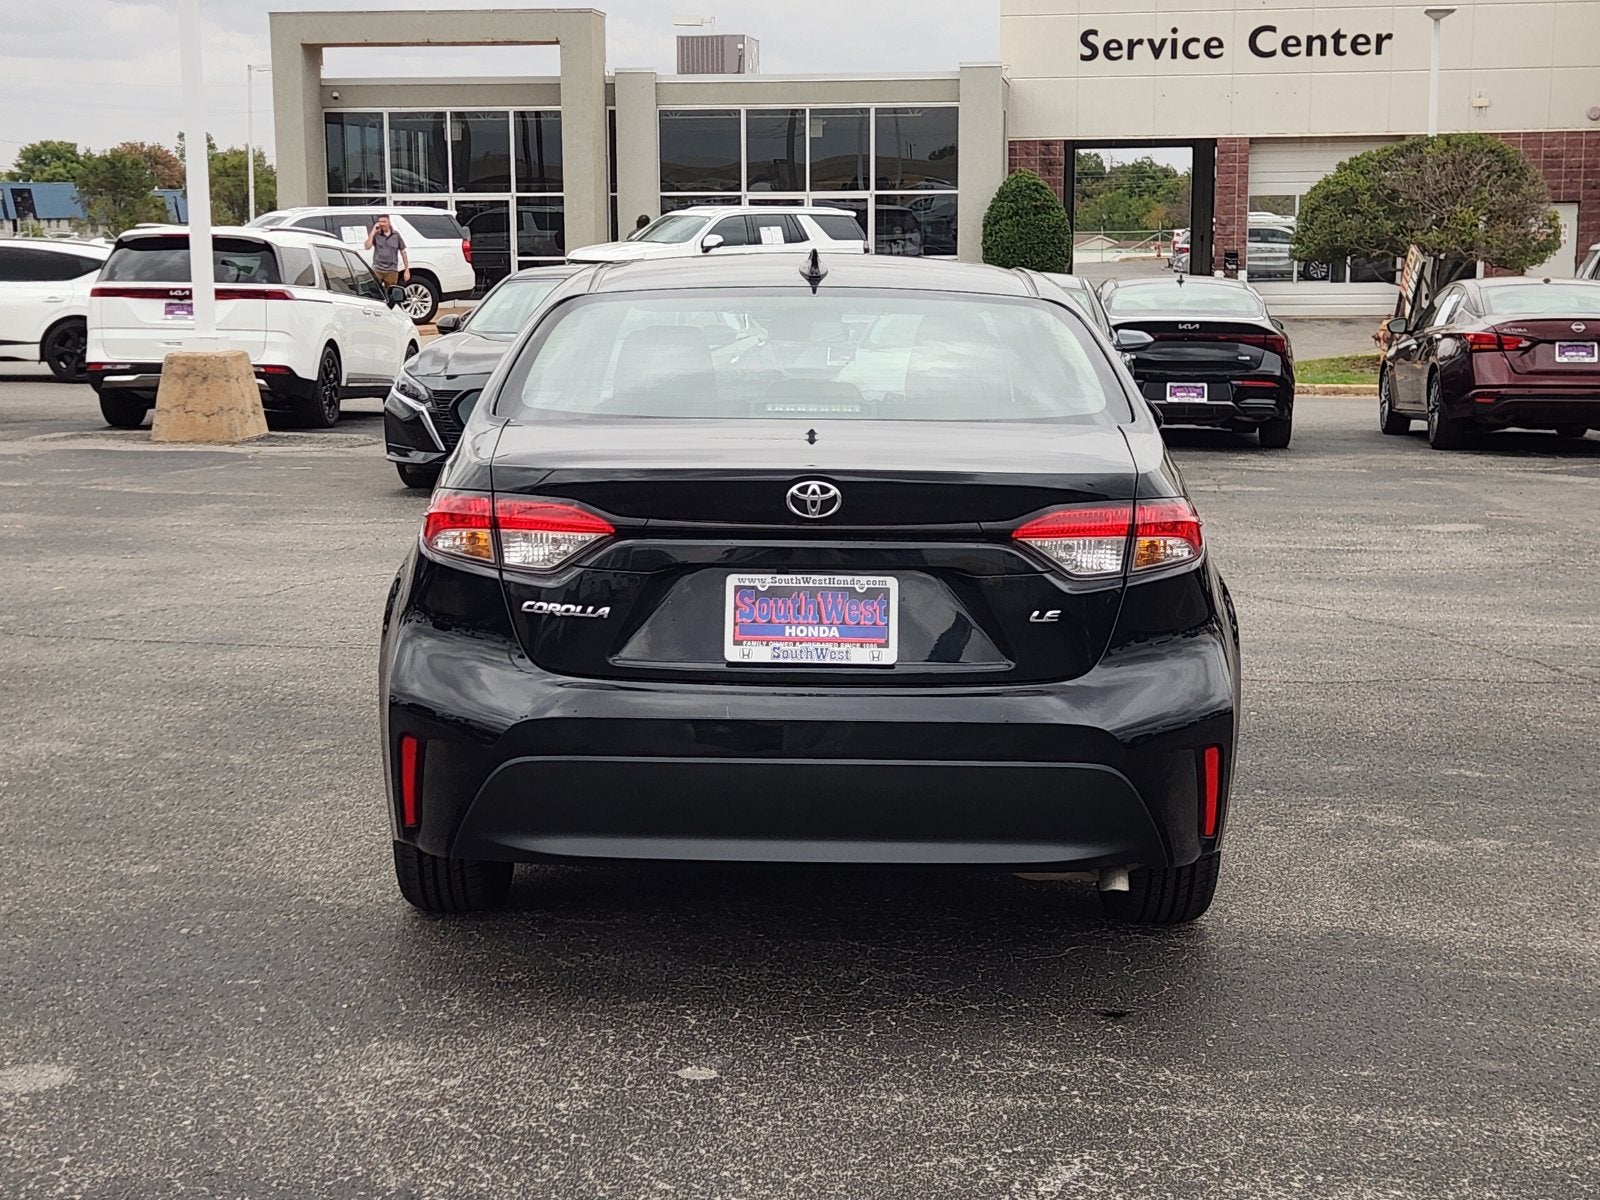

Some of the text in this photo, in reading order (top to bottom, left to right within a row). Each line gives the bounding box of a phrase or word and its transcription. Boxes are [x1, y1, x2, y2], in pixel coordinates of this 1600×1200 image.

[1079, 25, 1394, 62] Service Center
[521, 601, 611, 619] COROLLA
[735, 588, 888, 625] SouthWest
[1029, 610, 1062, 623] LE
[784, 625, 840, 638] HONDA
[771, 646, 850, 661] SouthWest
